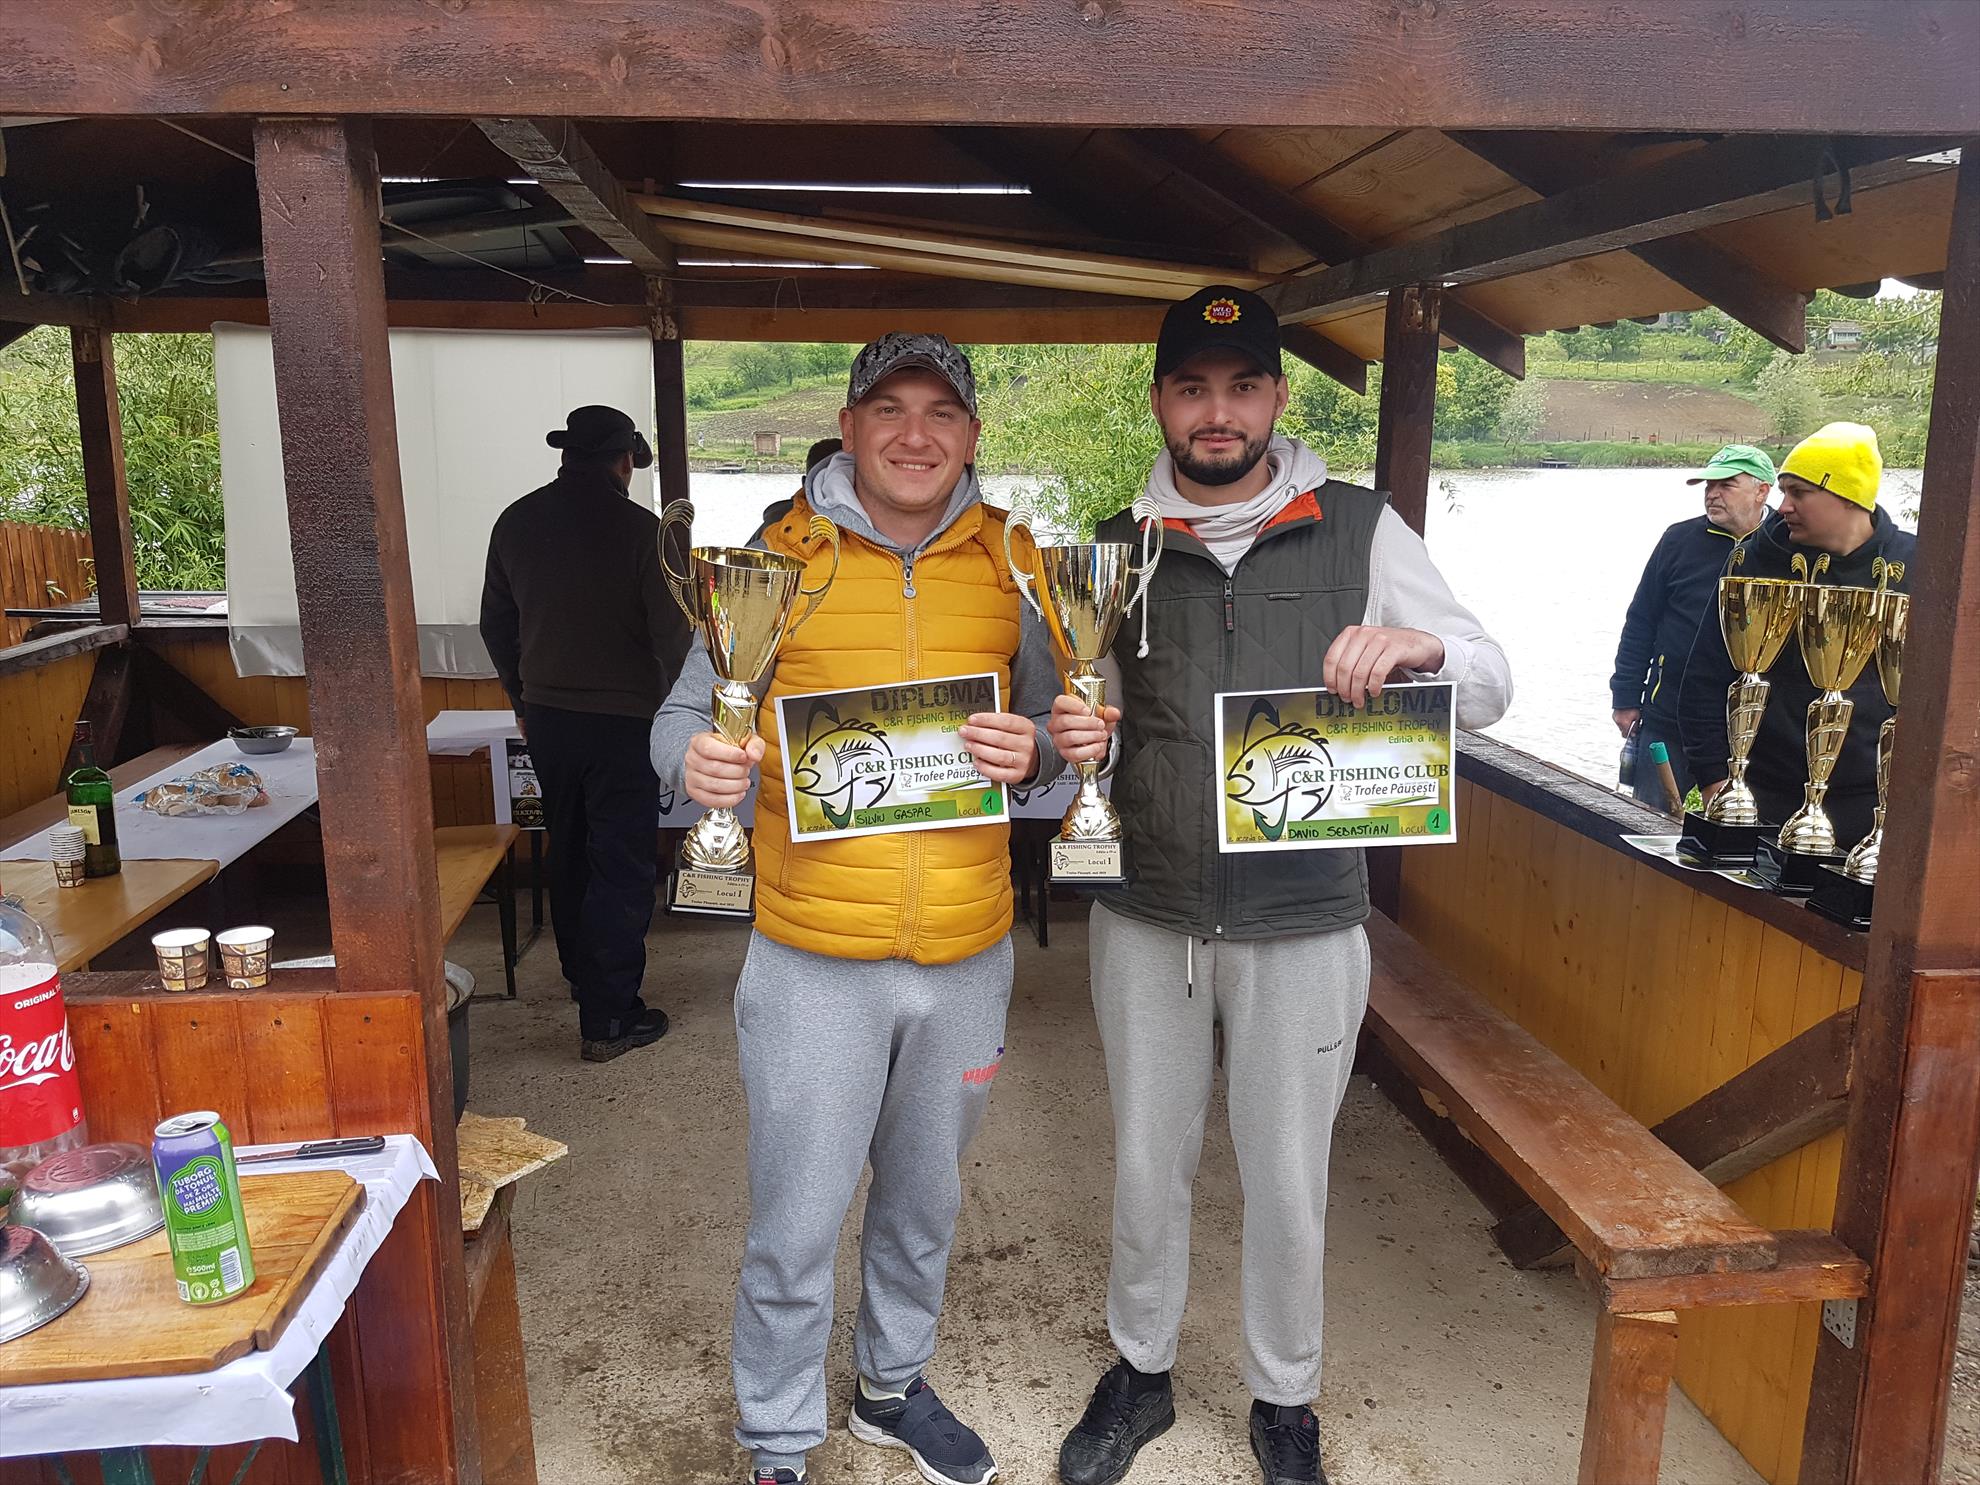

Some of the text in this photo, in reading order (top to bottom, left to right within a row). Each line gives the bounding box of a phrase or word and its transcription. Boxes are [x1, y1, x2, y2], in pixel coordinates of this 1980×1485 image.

[883, 716, 904, 728] C&R
[906, 712, 945, 727] FISHING
[1326, 719, 1440, 735] C&R FISHING TROPHY
[854, 760, 886, 774] C&R
[890, 753, 954, 771] FISHING
[914, 770, 945, 783] Trofee
[1291, 764, 1449, 784] C&R FISHING CLUB
[1355, 783, 1388, 796] Trofee
[986, 796, 993, 810] 1
[893, 808, 933, 820] GASPAR
[1432, 813, 1440, 828] 1
[1401, 825, 1428, 834] LOCUL
[14, 988, 57, 1010] ORIGINAL
[172, 1166, 212, 1189] TUBORG
[184, 1171, 217, 1191] TONUL!
[183, 1185, 221, 1208] MAI MULTE
[193, 1188, 201, 1196] 2
[201, 1183, 214, 1192] ORI
[192, 1262, 216, 1274] 500ml
